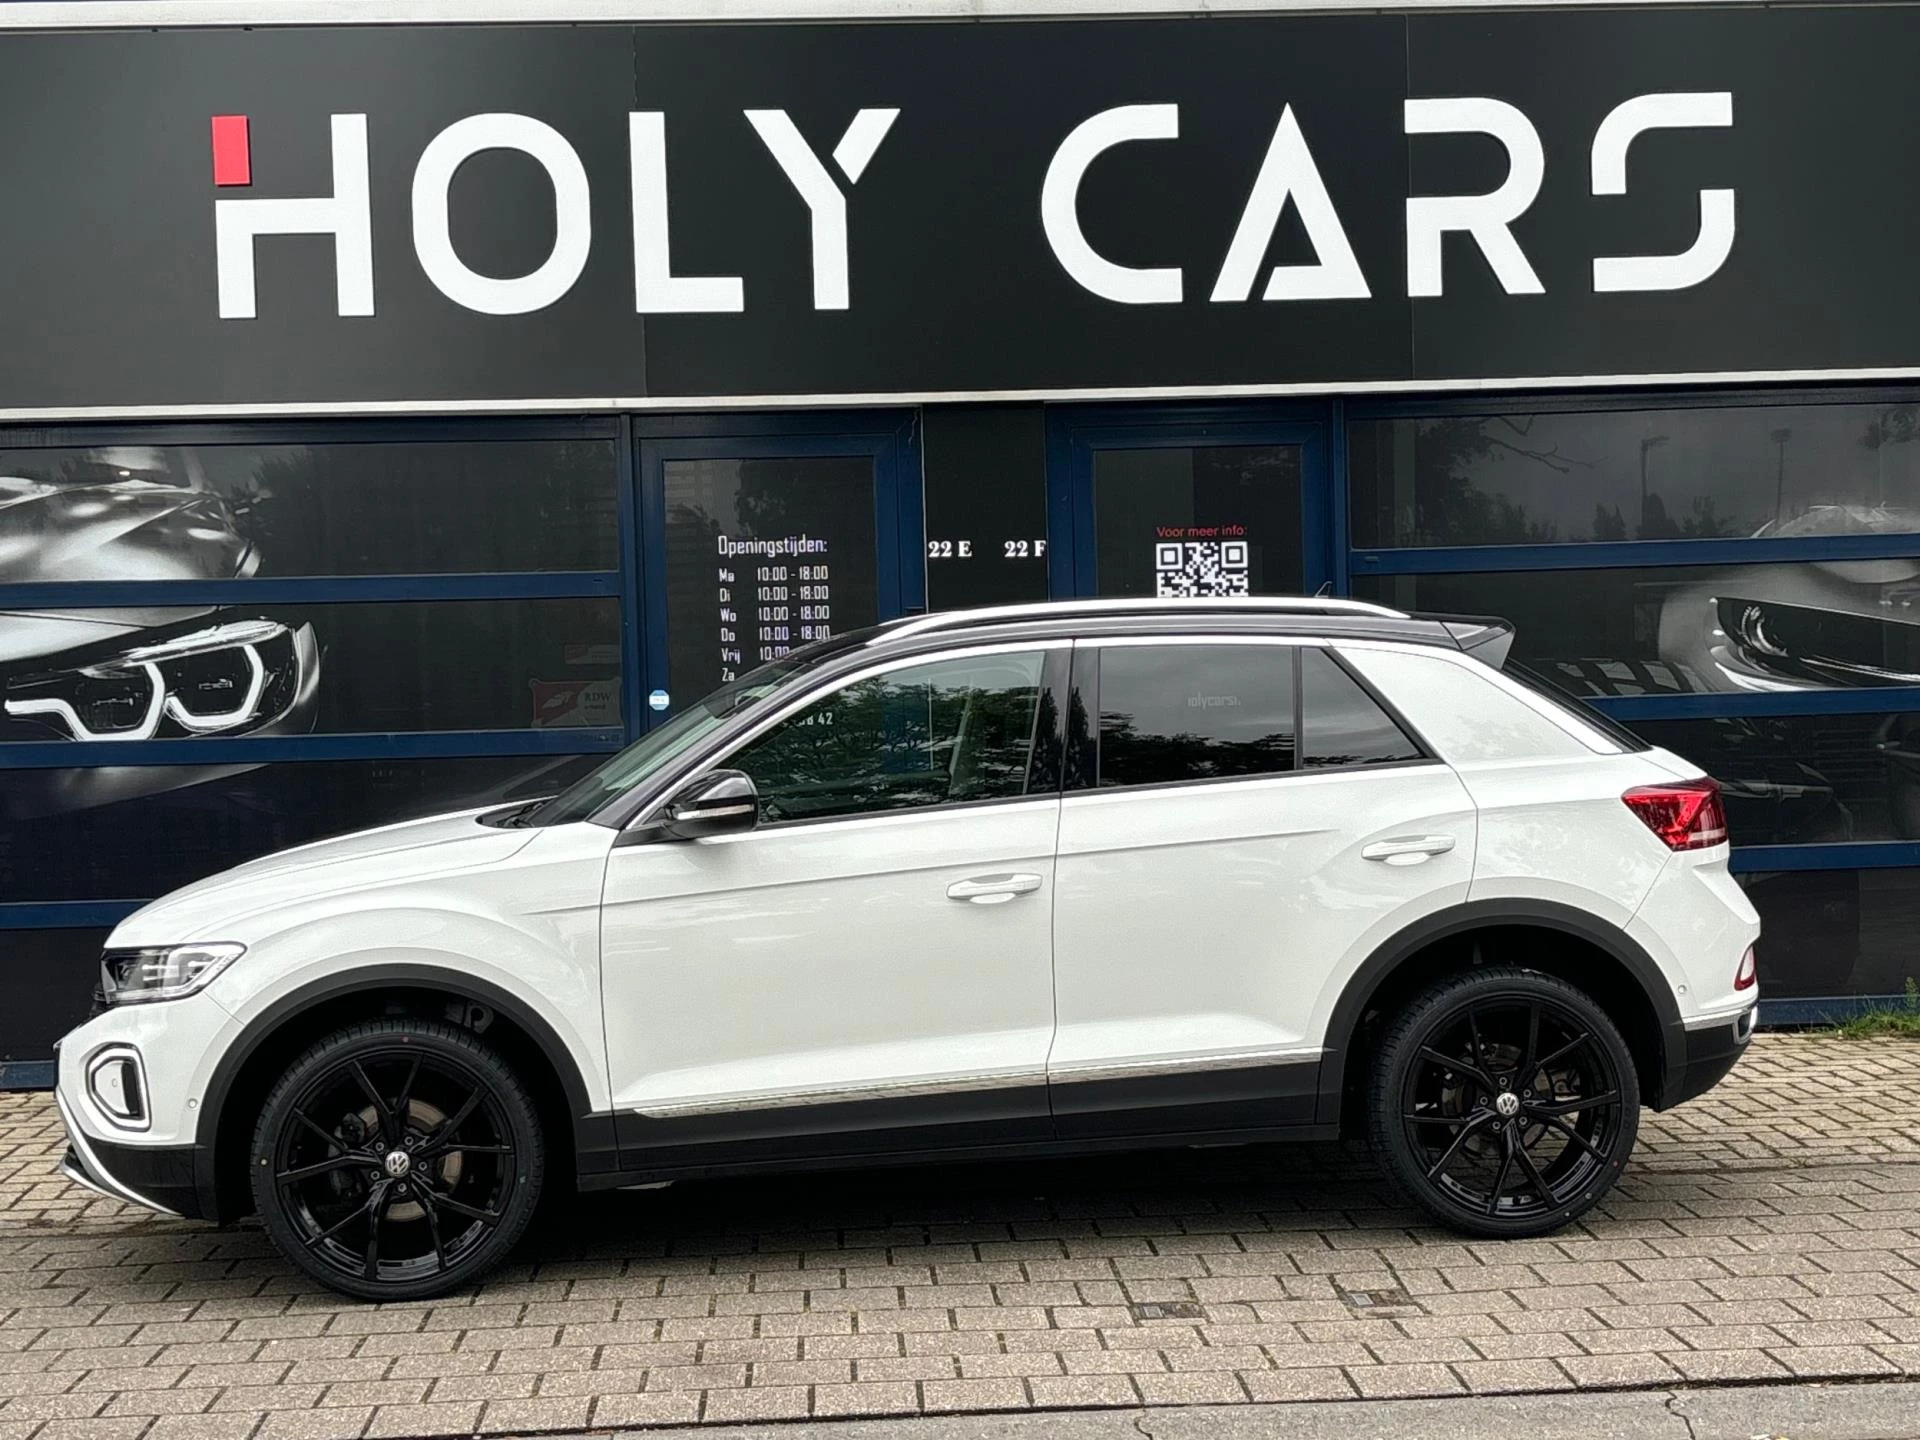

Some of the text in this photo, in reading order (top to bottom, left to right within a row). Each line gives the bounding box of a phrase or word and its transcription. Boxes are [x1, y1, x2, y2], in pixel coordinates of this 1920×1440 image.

[211, 91, 1736, 319] HOLY CARS
[1156, 524, 1248, 537] Voor meer info:
[718, 534, 828, 558] Openingstijden:
[928, 540, 972, 558] 22 E
[1004, 540, 1047, 558] 22 F
[719, 568, 735, 582] Ma
[757, 566, 787, 581] 10:00
[799, 565, 829, 580] 18:00
[719, 588, 731, 603] Di
[757, 586, 788, 601] 10:00
[799, 585, 829, 600] 18:00
[720, 607, 737, 623] Wo
[758, 606, 789, 622] 10:00
[800, 605, 830, 620] 18:00
[721, 627, 735, 643] Do
[759, 626, 790, 641] 10:00
[801, 625, 831, 640] 18:00
[721, 647, 741, 664] Vrij
[722, 668, 735, 682] Za
[817, 712, 833, 725] 42
